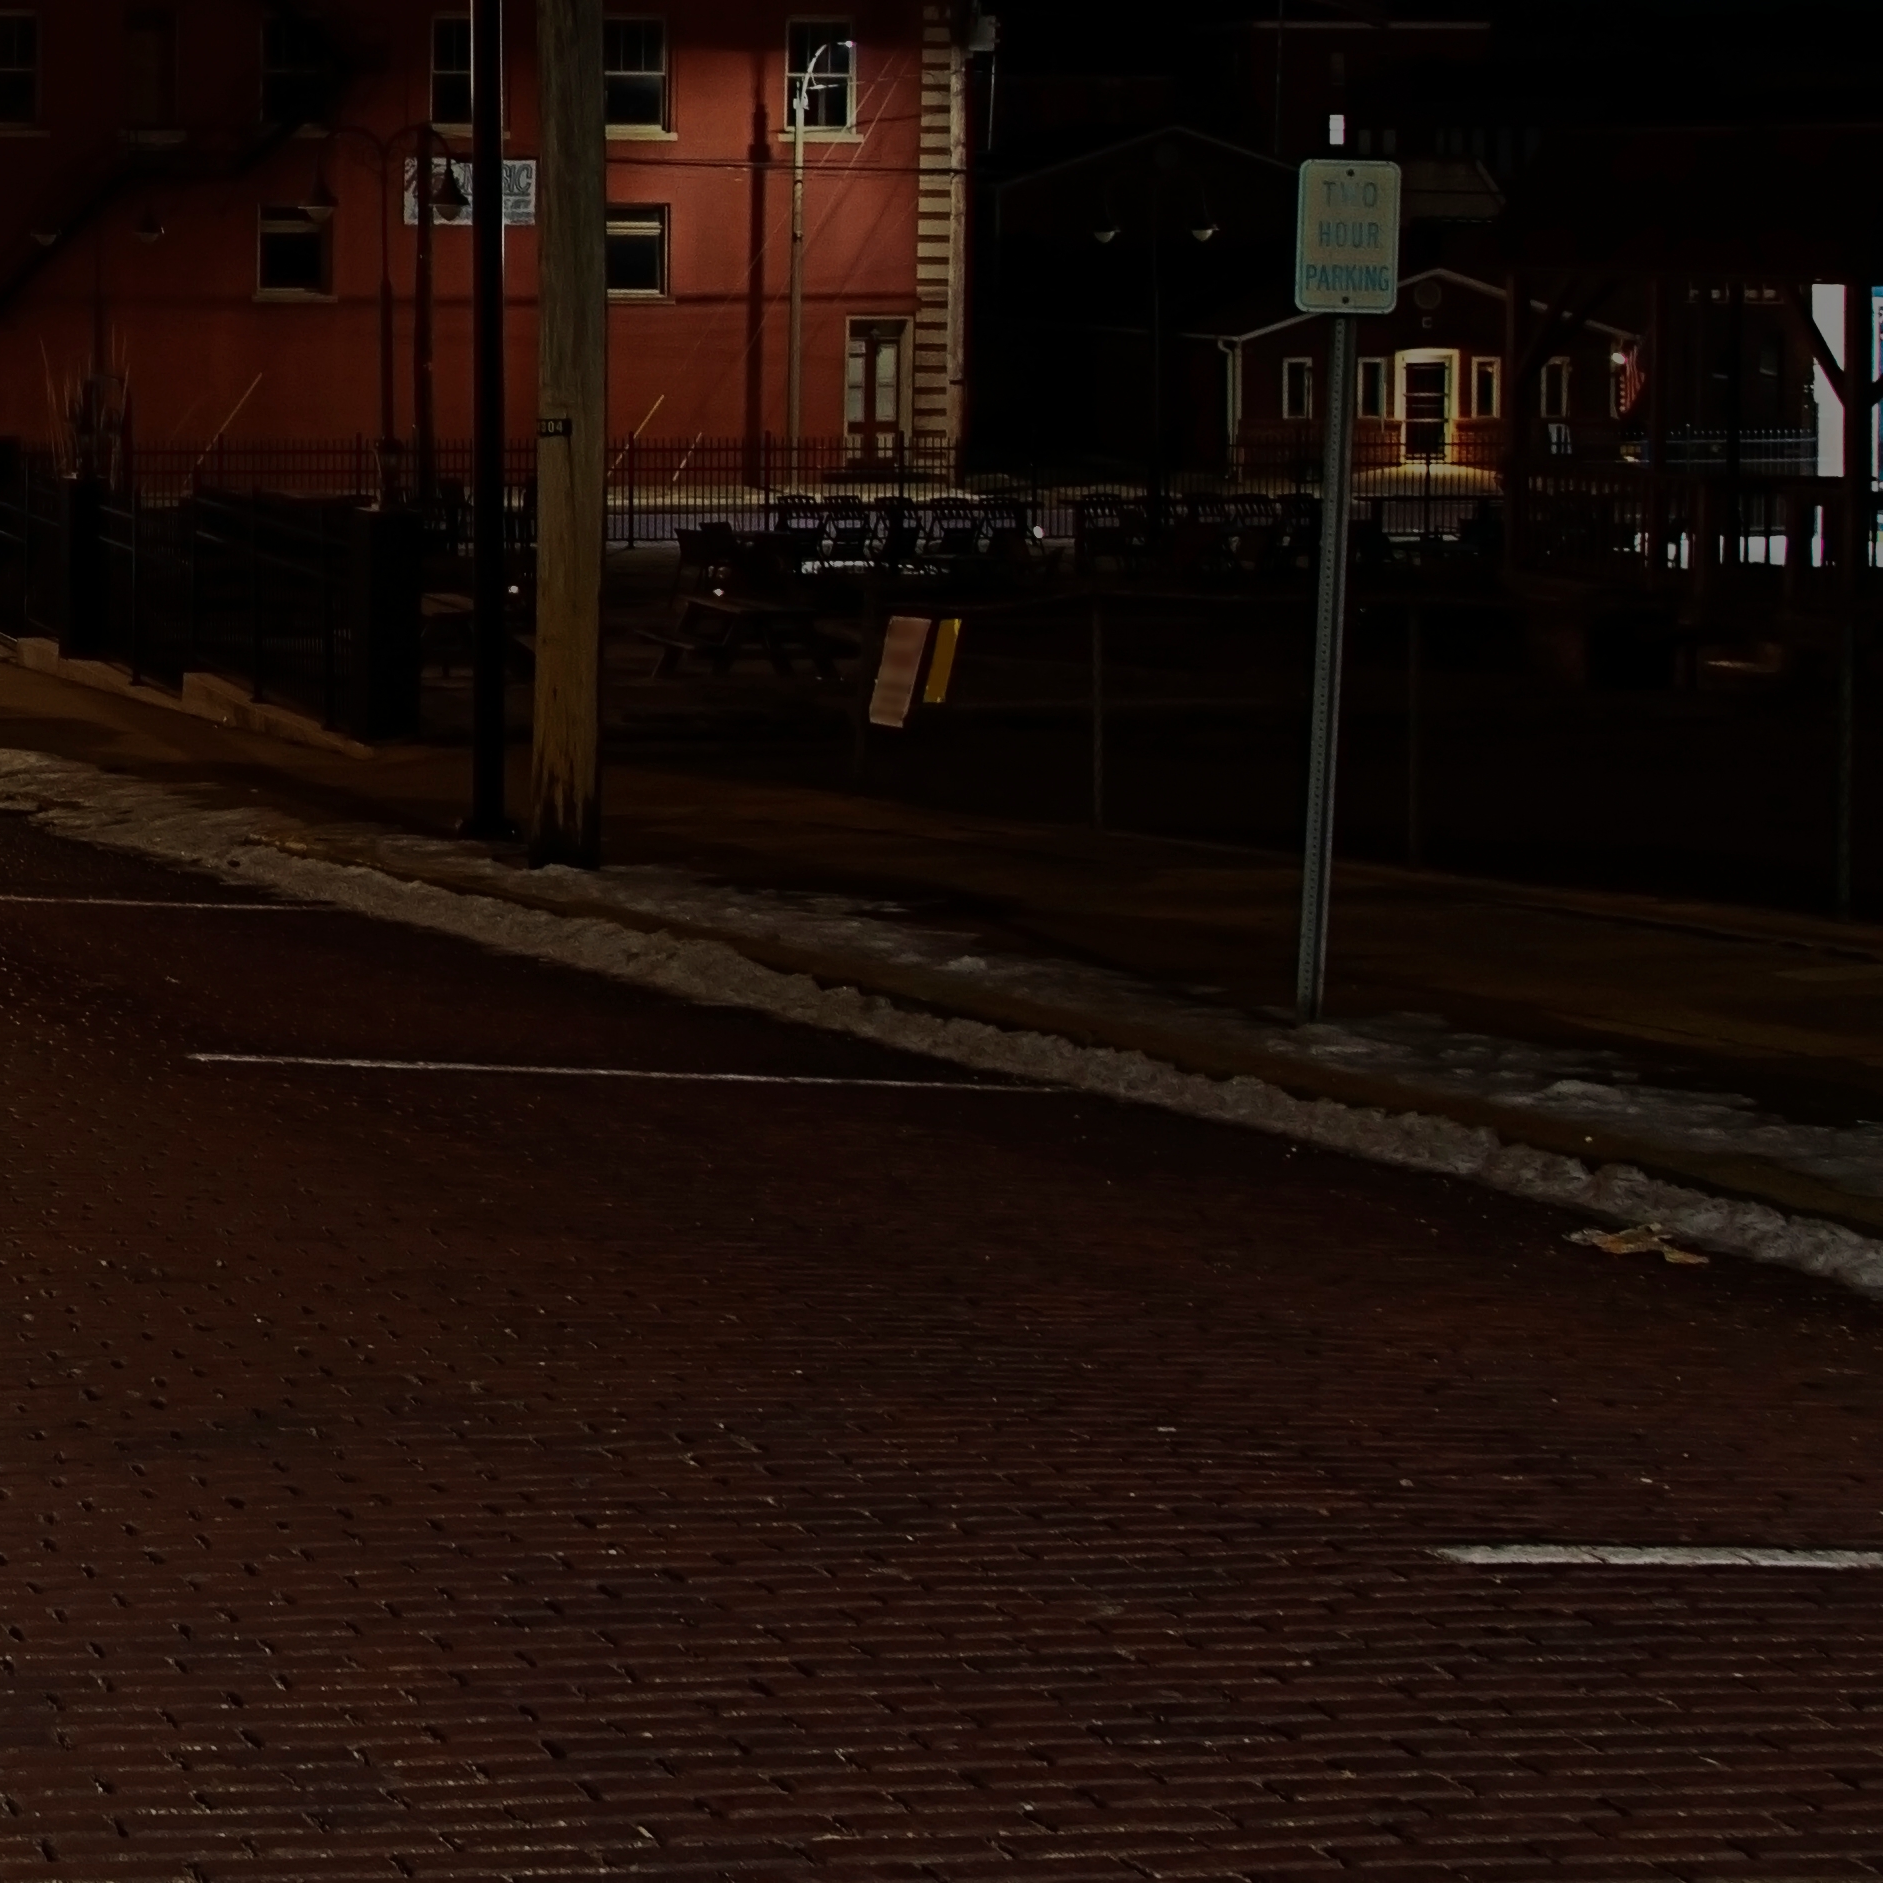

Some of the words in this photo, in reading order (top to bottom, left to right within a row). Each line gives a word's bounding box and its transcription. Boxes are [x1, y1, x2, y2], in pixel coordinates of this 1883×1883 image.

[1323, 180, 1378, 208] TWO
[1318, 221, 1382, 249] HOUR
[1305, 264, 1390, 292] PARKING
